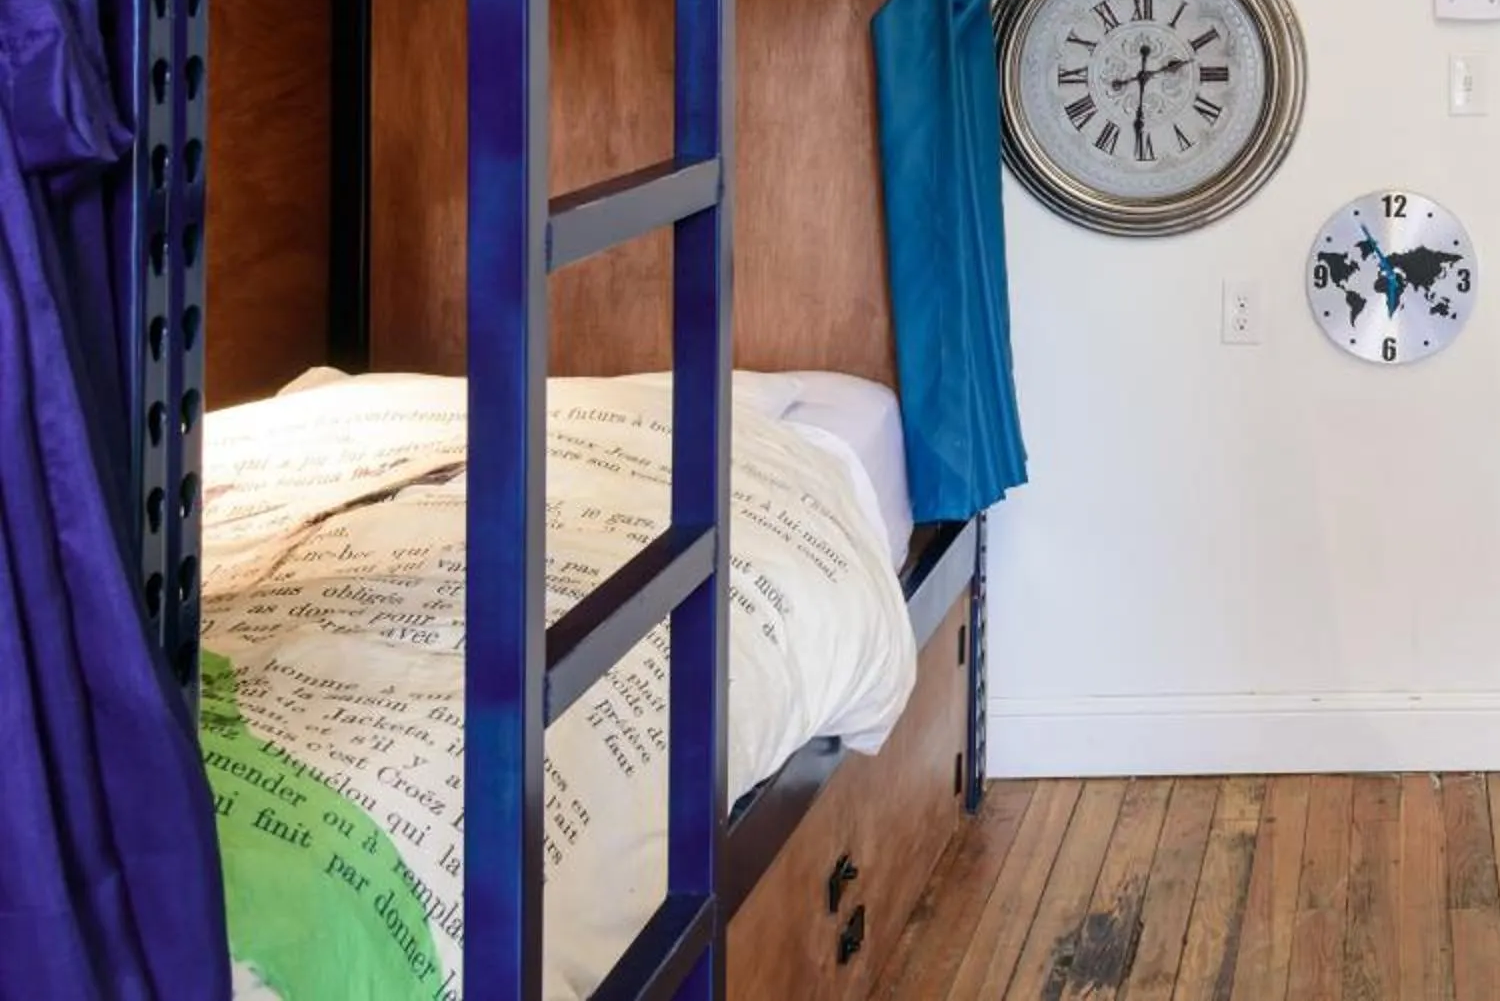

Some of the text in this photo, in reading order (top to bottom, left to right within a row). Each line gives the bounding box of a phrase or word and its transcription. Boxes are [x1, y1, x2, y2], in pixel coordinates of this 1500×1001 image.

[1092, 0, 1122, 35] XI
[1168, 0, 1188, 29] I
[1189, 27, 1220, 52] II
[1058, 65, 1088, 87] IX
[1199, 66, 1230, 82] III
[1065, 94, 1098, 132] VIII
[1095, 120, 1120, 156] VII
[1381, 194, 1407, 218] 12
[1314, 264, 1328, 289] 9
[1457, 269, 1471, 293] 3
[1382, 337, 1397, 362] 6
[322, 810, 357, 838] ou
[386, 810, 432, 846] qui
[251, 807, 315, 849] finit
[324, 853, 371, 893] par
